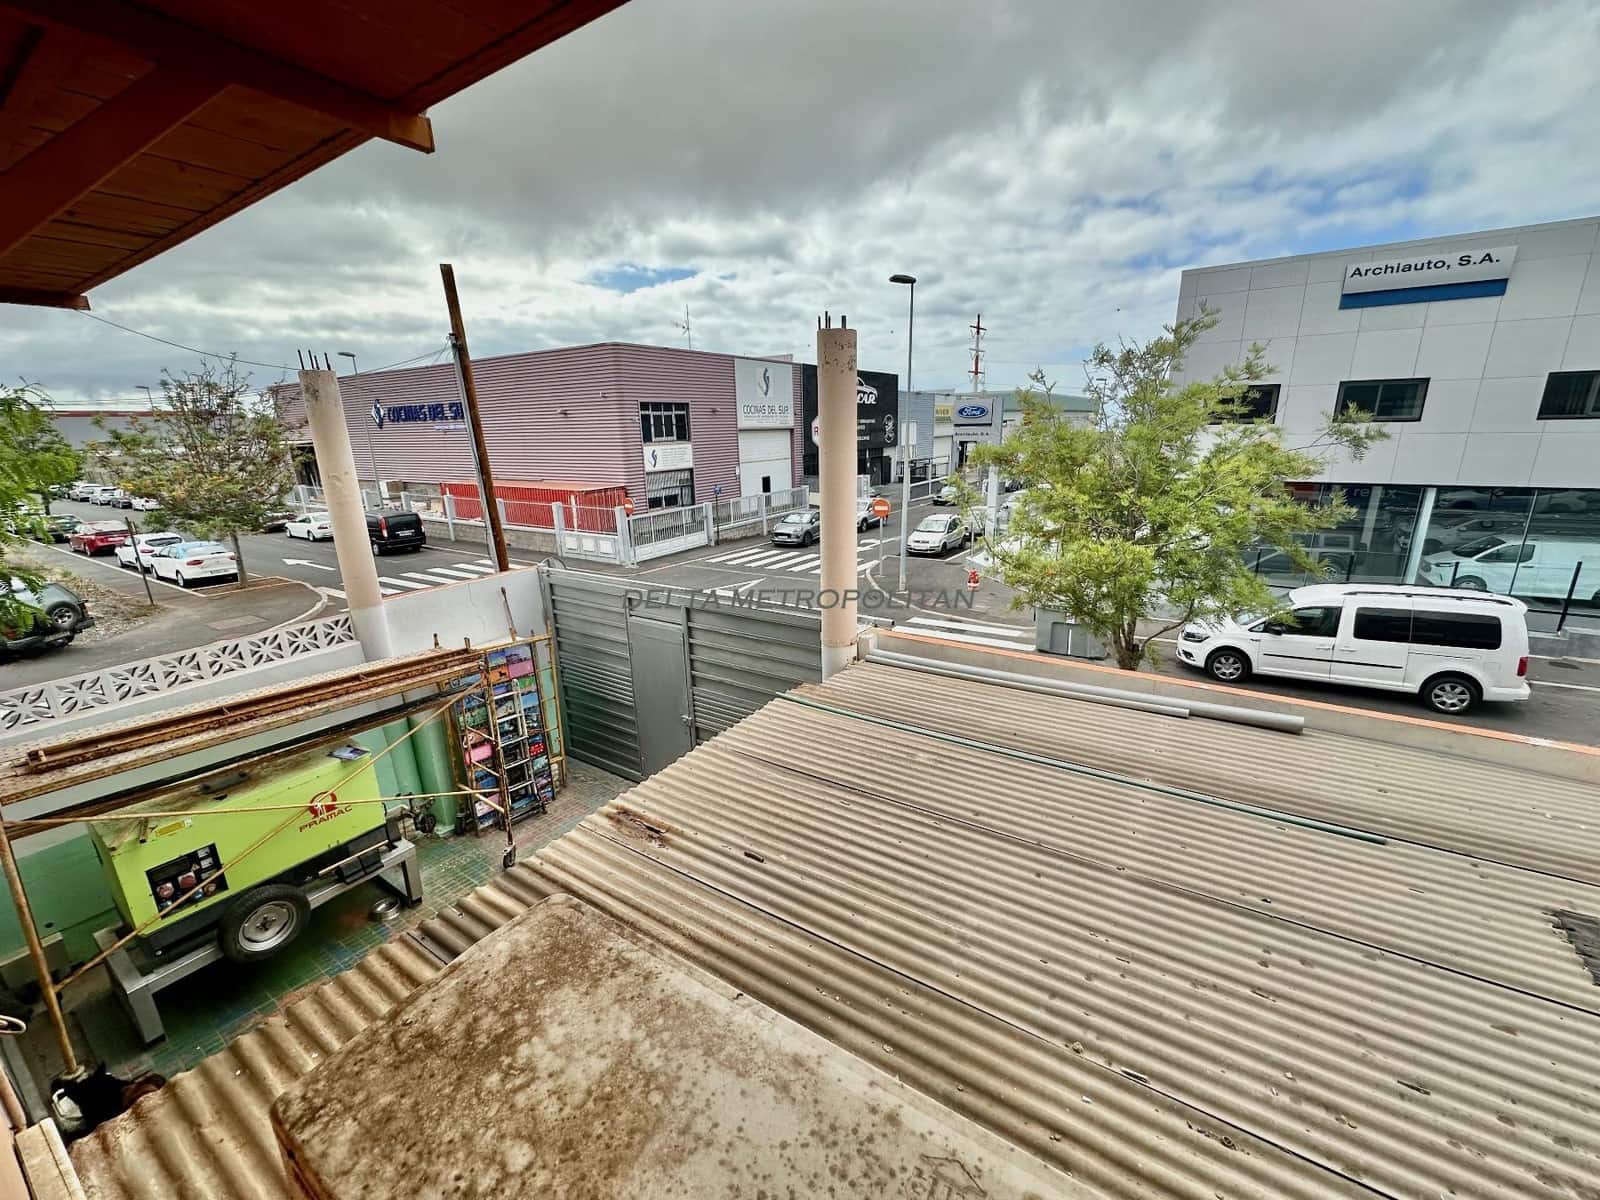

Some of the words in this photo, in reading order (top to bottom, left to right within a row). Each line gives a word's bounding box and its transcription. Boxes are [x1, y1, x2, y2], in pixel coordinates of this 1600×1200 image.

[1350, 258, 1451, 278] Archiauto,
[1458, 252, 1500, 267] S.A.
[448, 402, 466, 420] SU
[961, 405, 983, 415] Ford
[299, 804, 352, 832] PRAMAC
